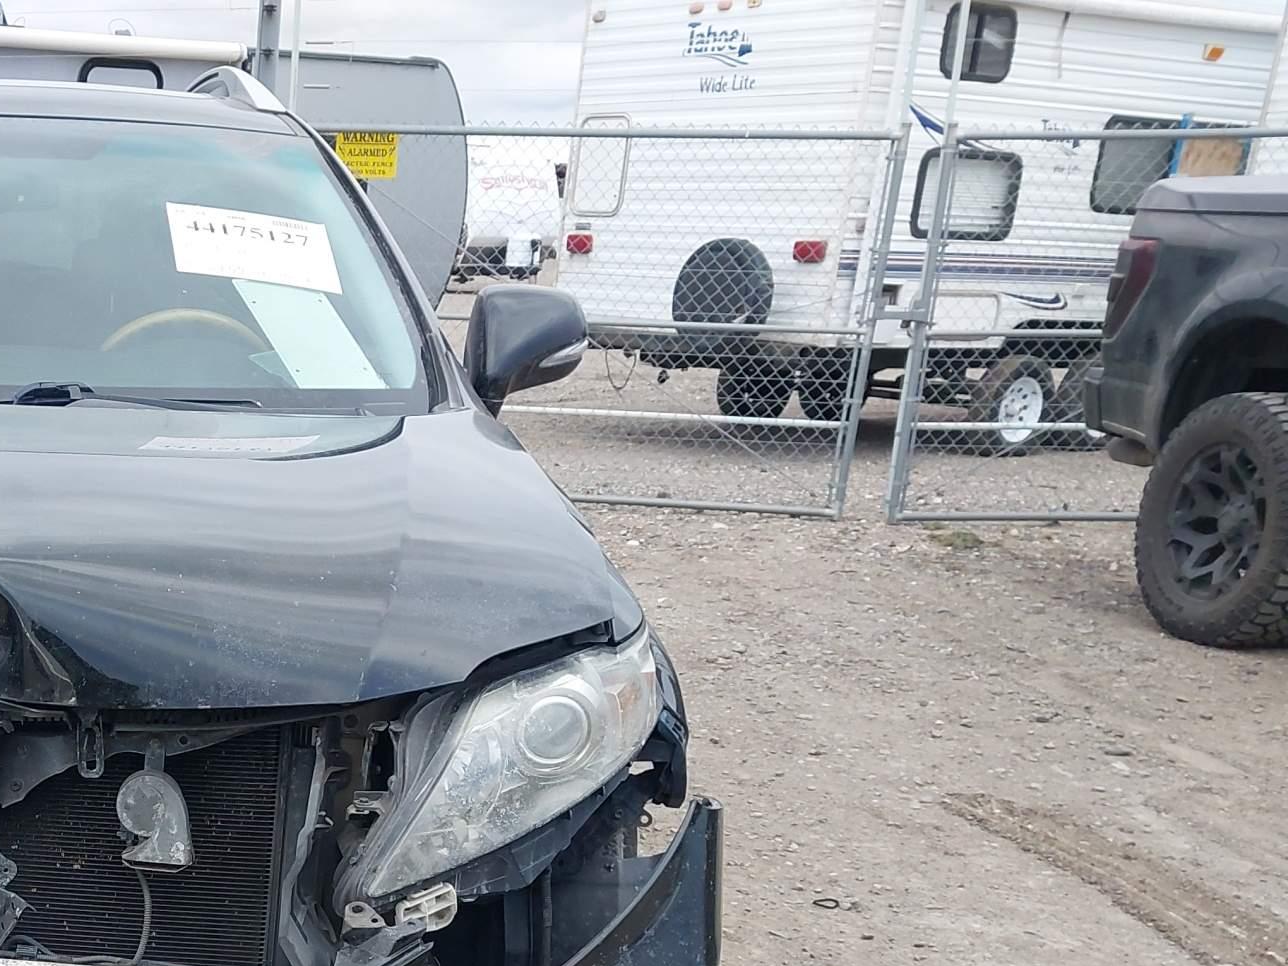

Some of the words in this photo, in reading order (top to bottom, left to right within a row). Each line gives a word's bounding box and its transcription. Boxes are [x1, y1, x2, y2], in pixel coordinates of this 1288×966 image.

[687, 22, 740, 53] Tahoe
[699, 76, 728, 93] Wide
[732, 74, 756, 91] Lite
[343, 131, 395, 143] WARNING
[347, 148, 388, 157] ALARMED
[186, 220, 309, 247] 44175127
